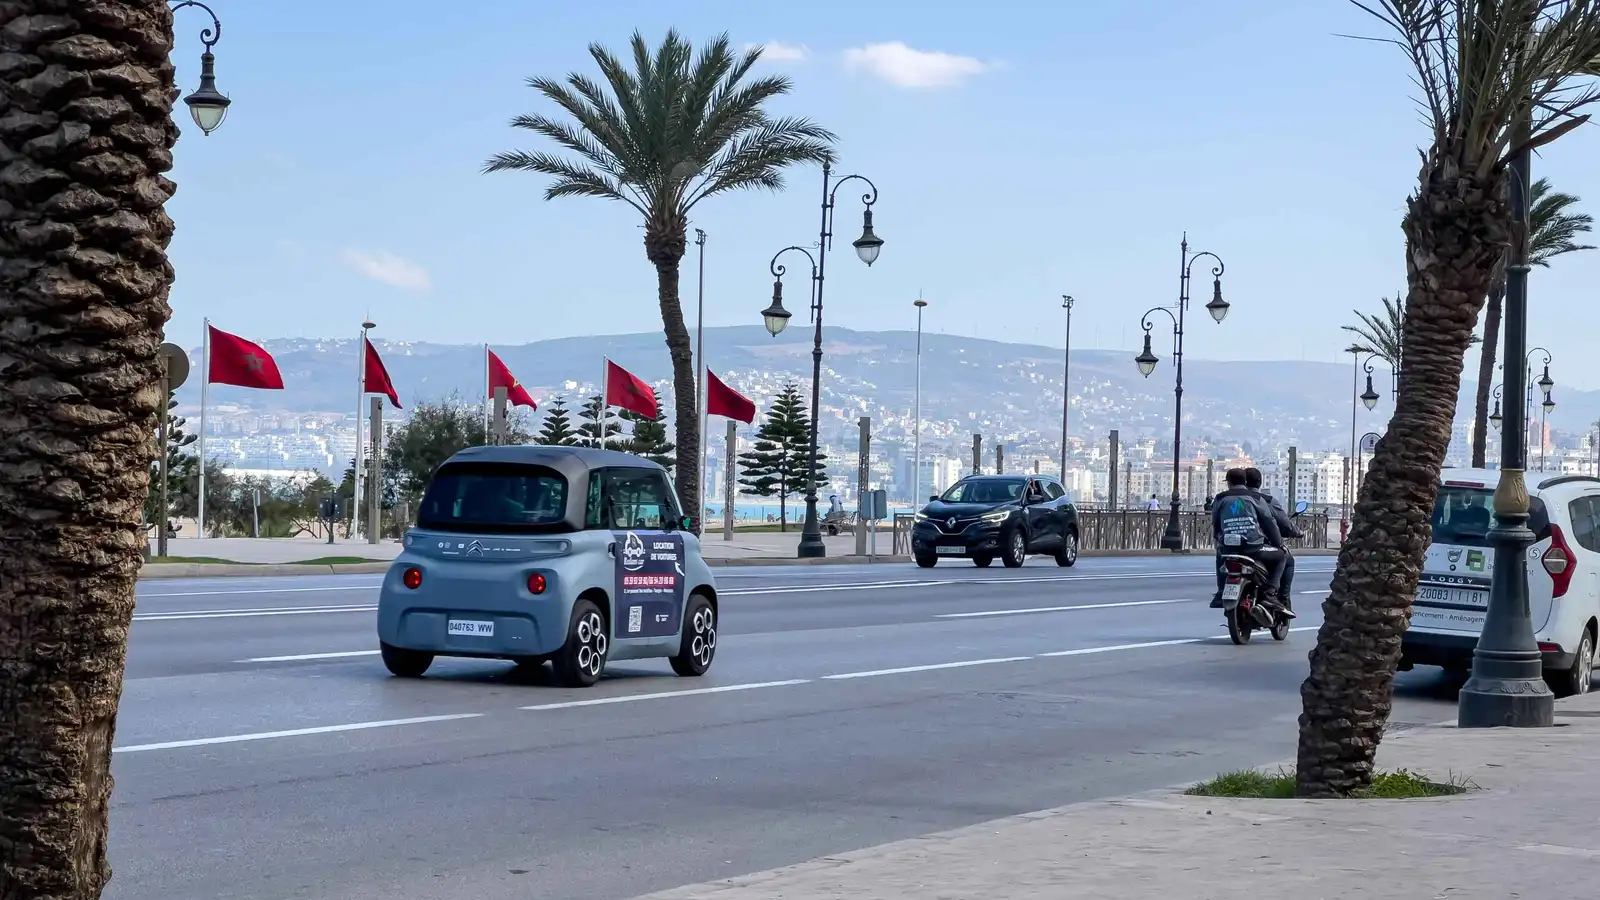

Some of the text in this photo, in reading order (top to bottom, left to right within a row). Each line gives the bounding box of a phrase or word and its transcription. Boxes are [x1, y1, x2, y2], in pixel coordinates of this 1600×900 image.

[1420, 588, 1448, 600] 20083
[1472, 592, 1482, 603] 81
[450, 622, 492, 633] 040763 WW
